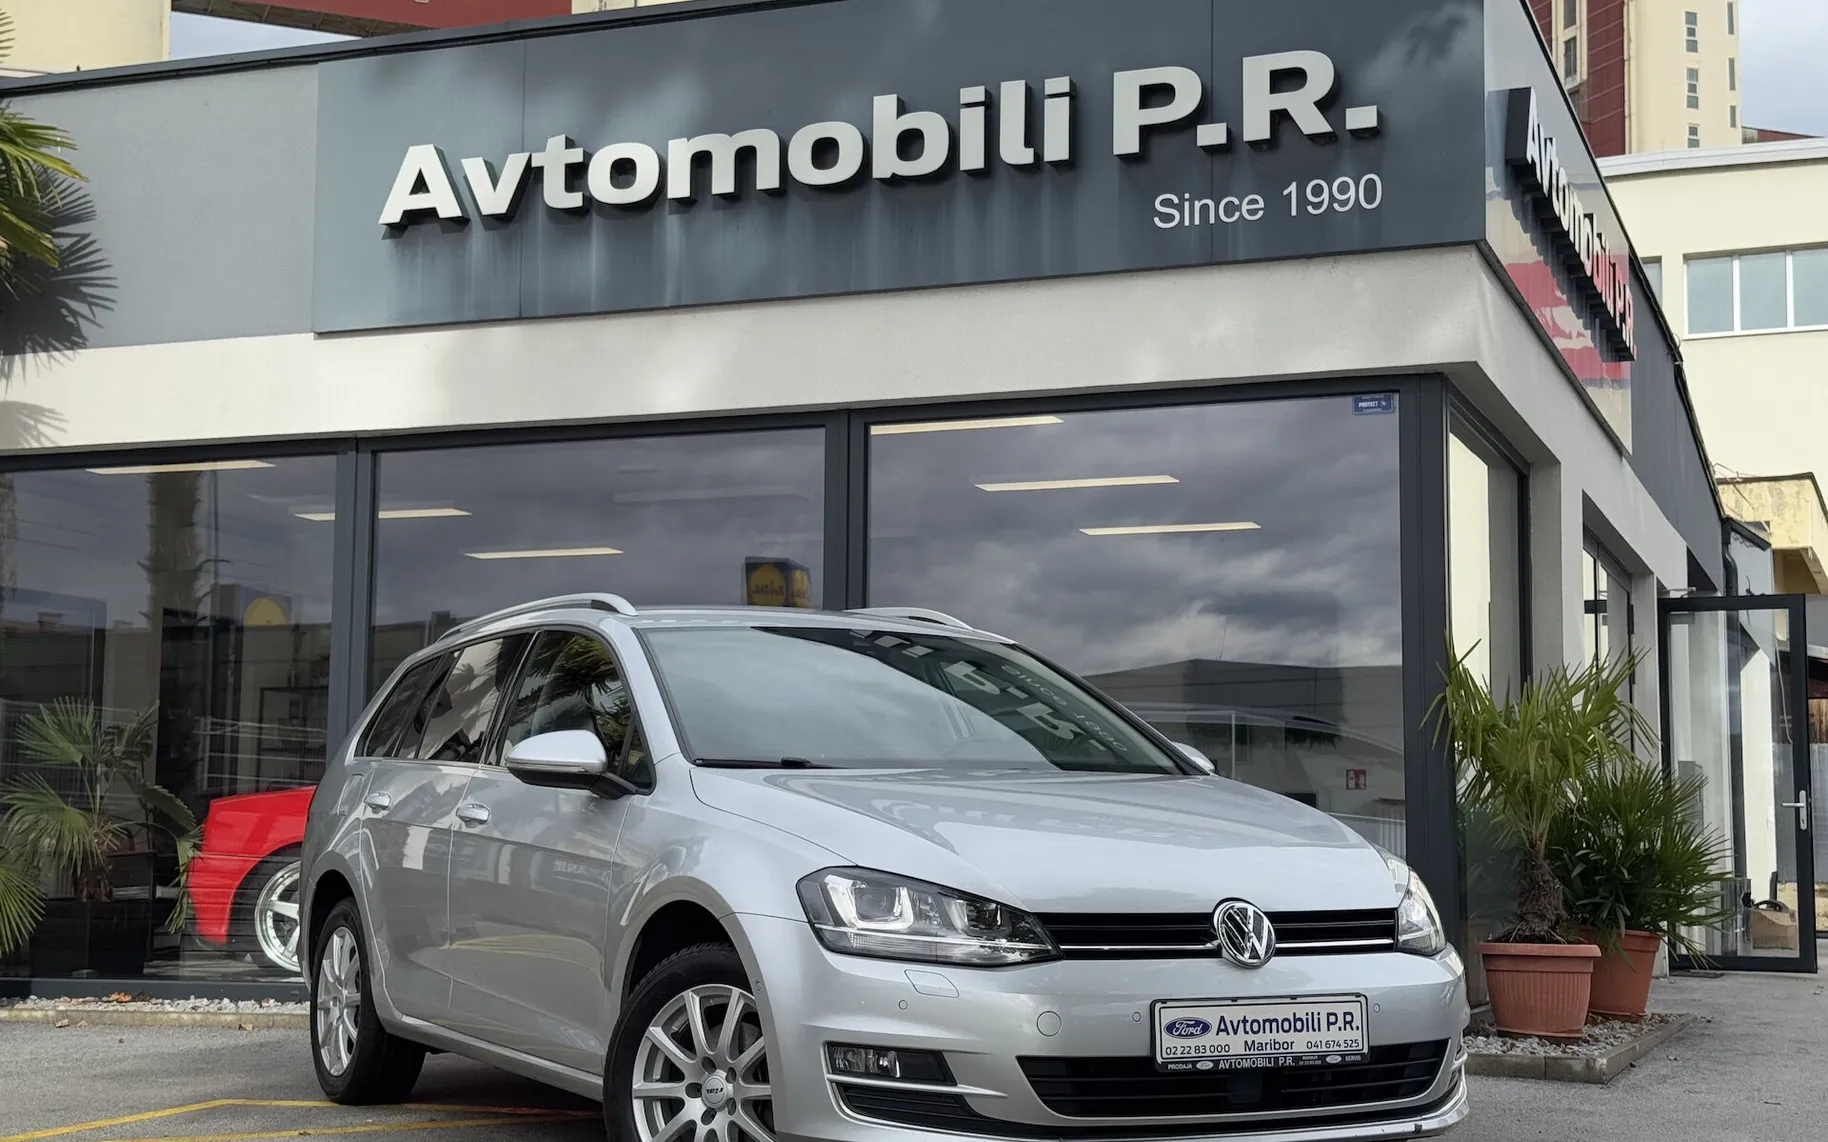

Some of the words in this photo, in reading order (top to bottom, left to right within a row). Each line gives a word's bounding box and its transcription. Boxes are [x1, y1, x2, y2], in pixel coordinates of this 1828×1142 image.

[378, 76, 1070, 226] Avtomobili
[1112, 50, 1378, 156] P.R.
[1153, 192, 1265, 229] Since
[1282, 173, 1383, 217] 1990
[1525, 86, 1614, 318] Avtomobili
[1615, 264, 1637, 361] P.R.
[1358, 400, 1379, 408] PROTECT
[1172, 1020, 1203, 1036] Ford
[1215, 1011, 1322, 1036] Avtomobili
[1326, 1011, 1360, 1032] P.R.
[1165, 1046, 1178, 1056] 02
[1180, 1045, 1192, 1055] 22
[1194, 1044, 1207, 1054] 83
[1209, 1044, 1231, 1053] 000
[1244, 1038, 1295, 1052] Maribor
[1306, 1040, 1323, 1049] 041
[1325, 1040, 1341, 1049] 674
[1343, 1039, 1359, 1048] 525
[1218, 1057, 1275, 1070] AVTOMOBILI
[1278, 1056, 1296, 1066] P.R.
